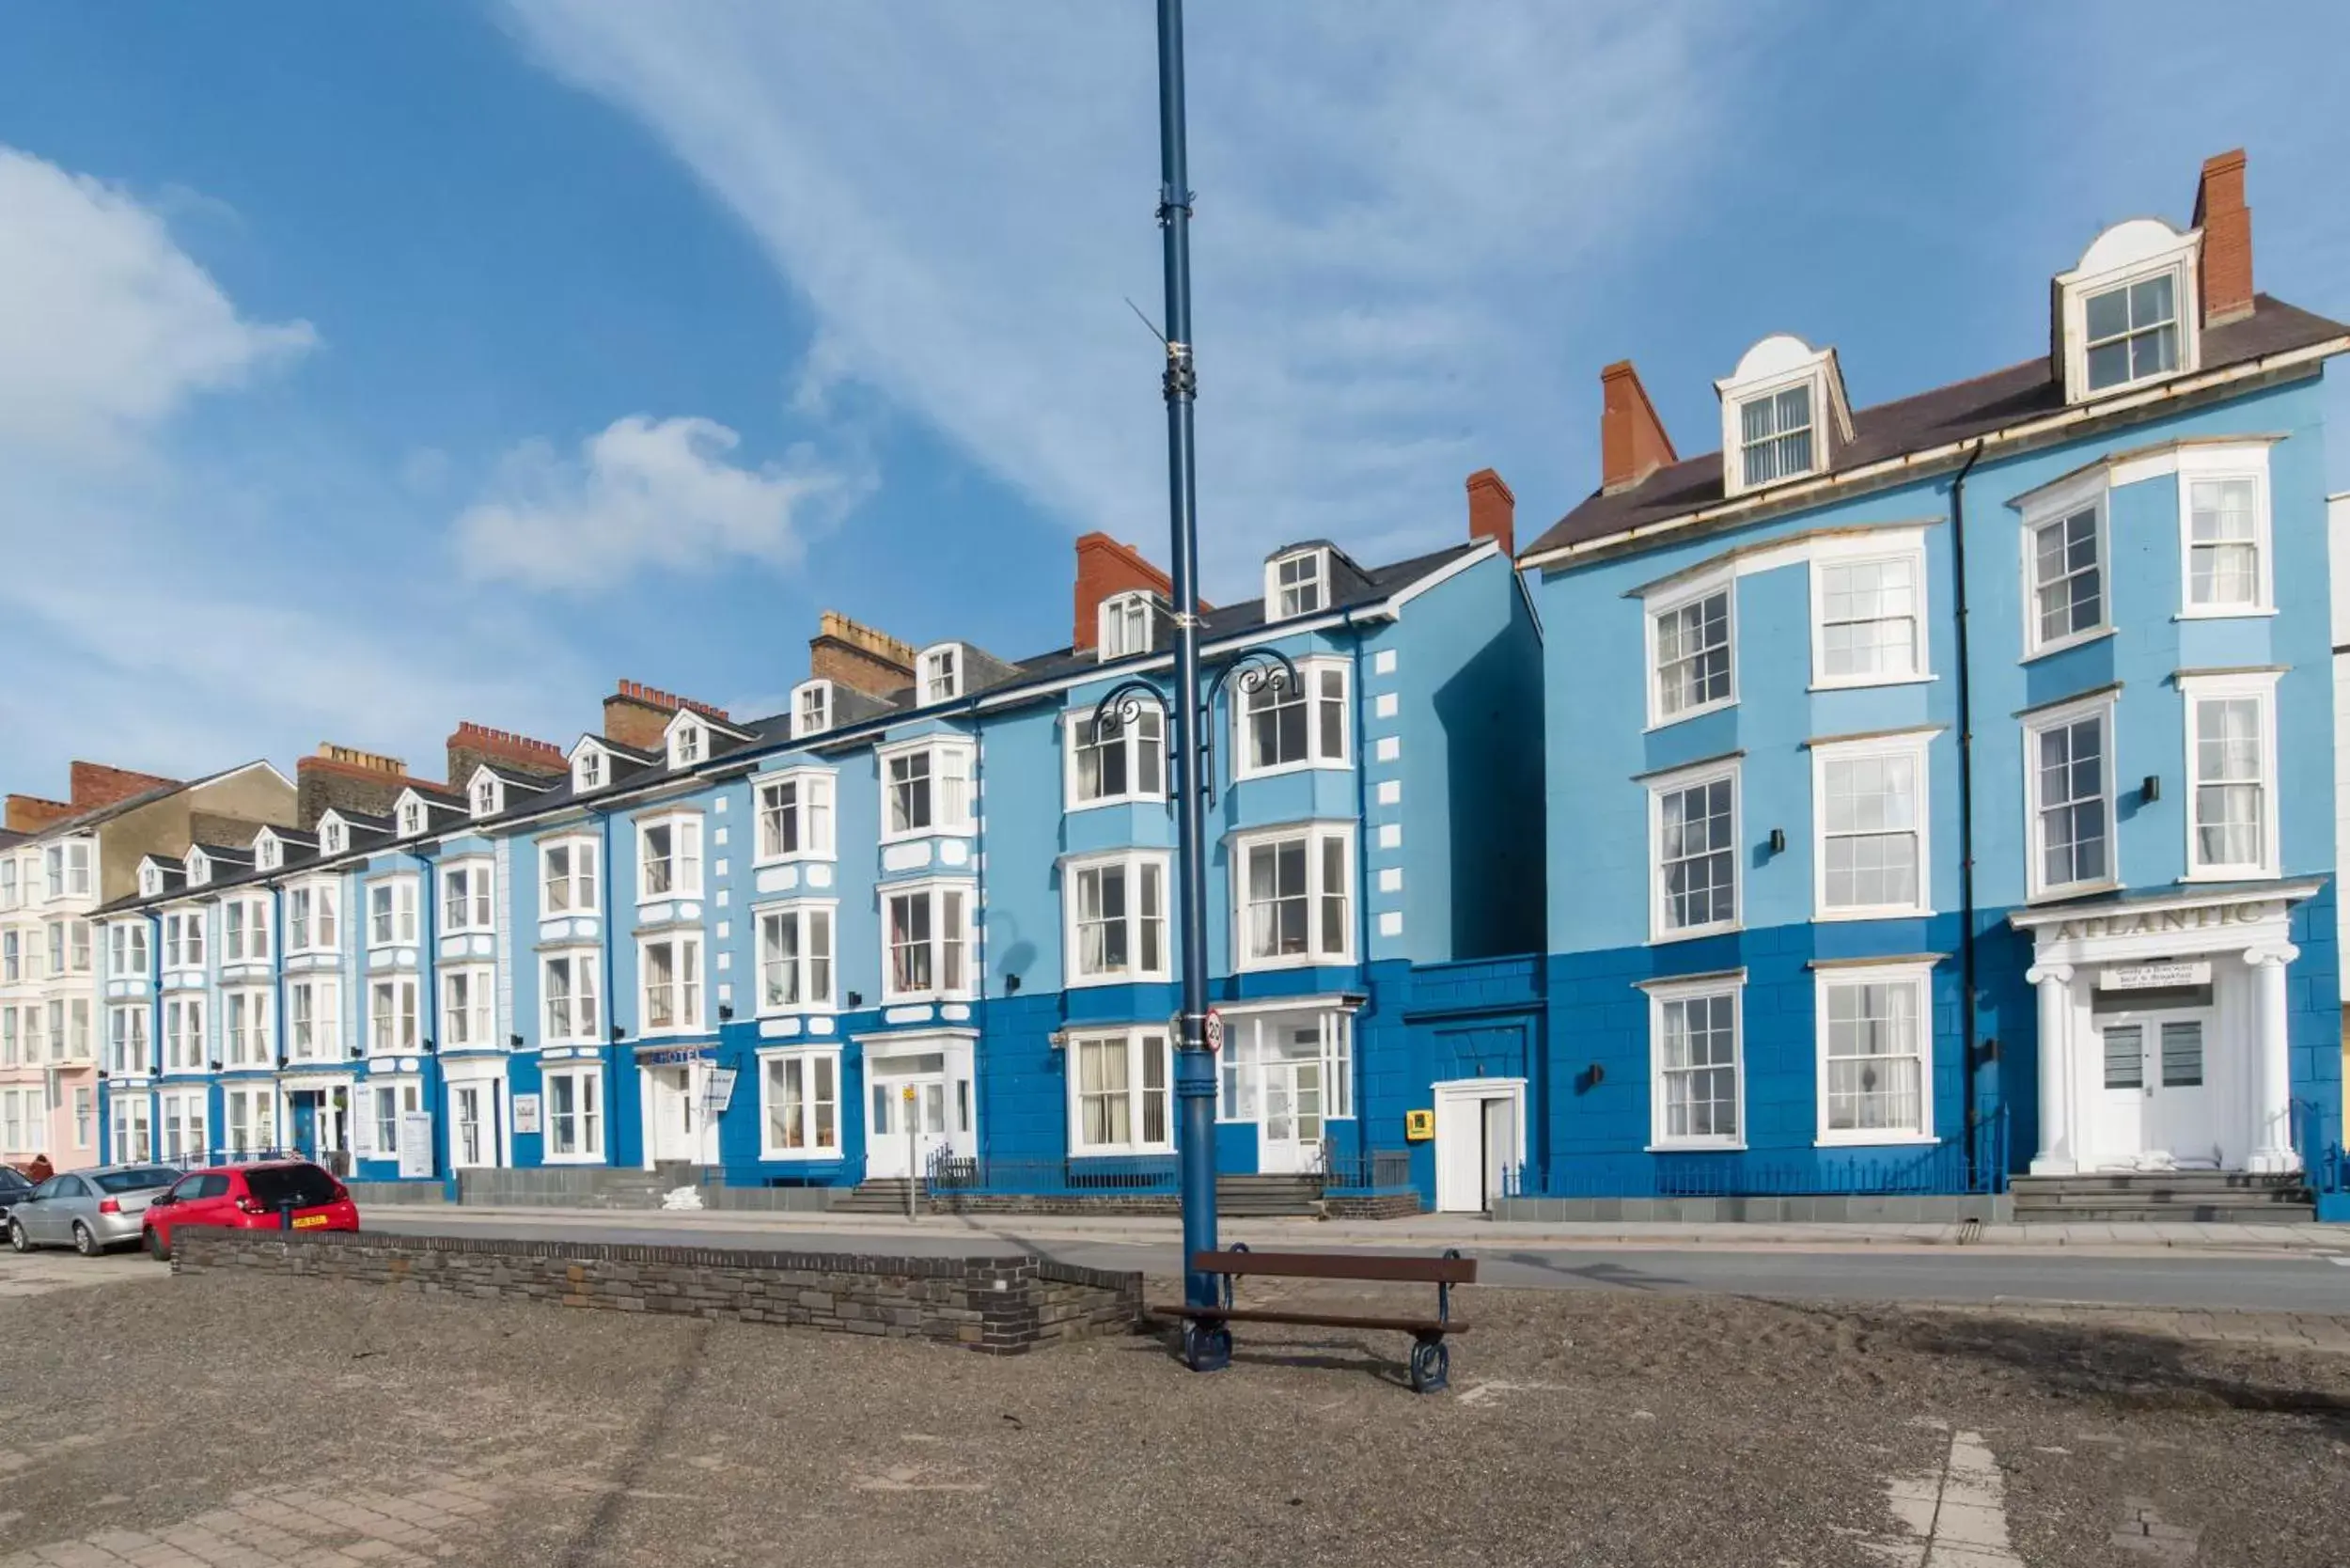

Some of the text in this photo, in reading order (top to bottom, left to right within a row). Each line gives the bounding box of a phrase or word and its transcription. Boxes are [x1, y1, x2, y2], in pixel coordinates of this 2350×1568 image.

[2056, 901, 2264, 940] ATLANTIC
[1209, 1022, 1219, 1040] 20
[660, 1048, 700, 1065] HOTEL
